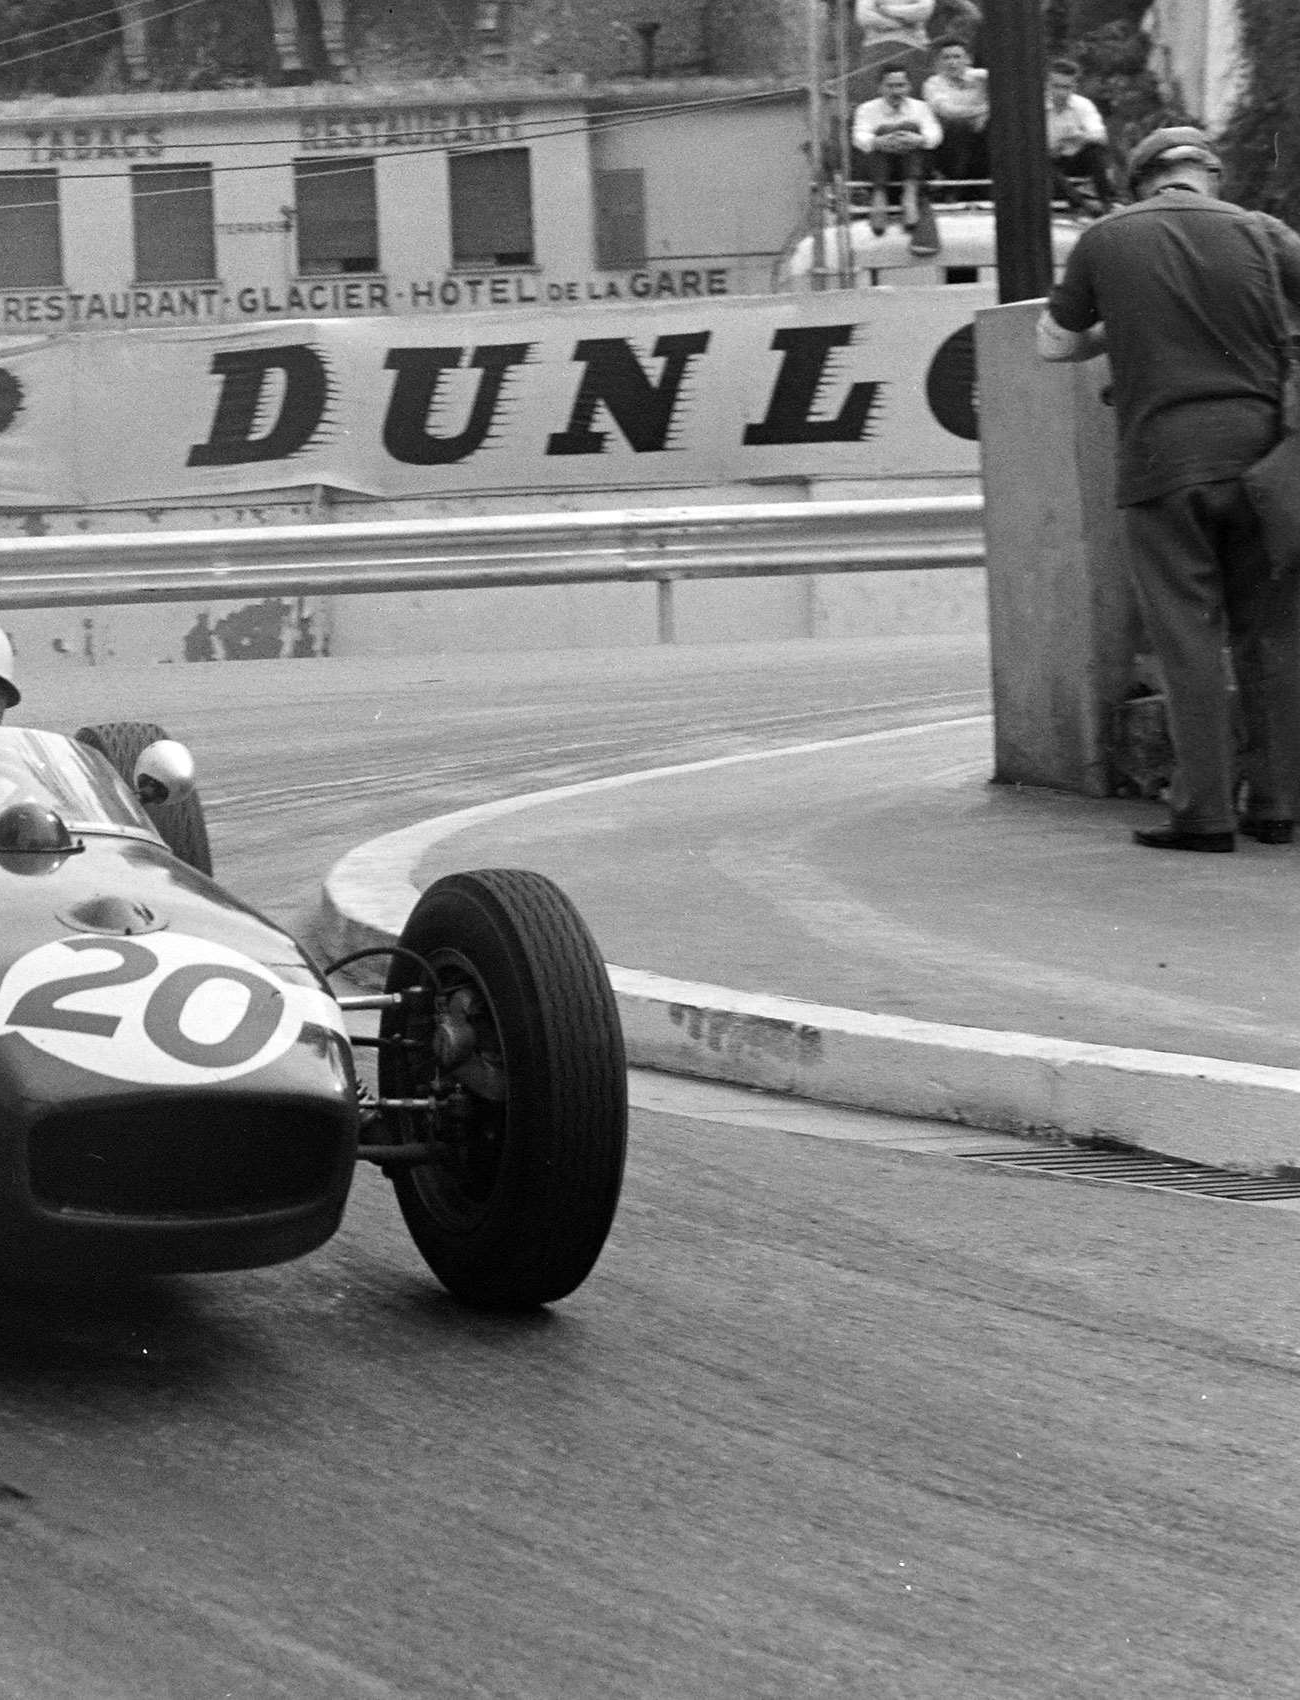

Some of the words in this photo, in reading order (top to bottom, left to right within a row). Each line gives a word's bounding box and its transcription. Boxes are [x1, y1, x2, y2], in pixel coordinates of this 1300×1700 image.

[25, 124, 163, 163] TABACS
[3, 285, 219, 324] RESTAURANT
[236, 278, 392, 315] GLACIER
[410, 278, 538, 309] HOTEL
[547, 282, 579, 303] DE
[587, 279, 622, 301] LA
[629, 267, 729, 300] GARE
[5, 937, 284, 1068] 20
